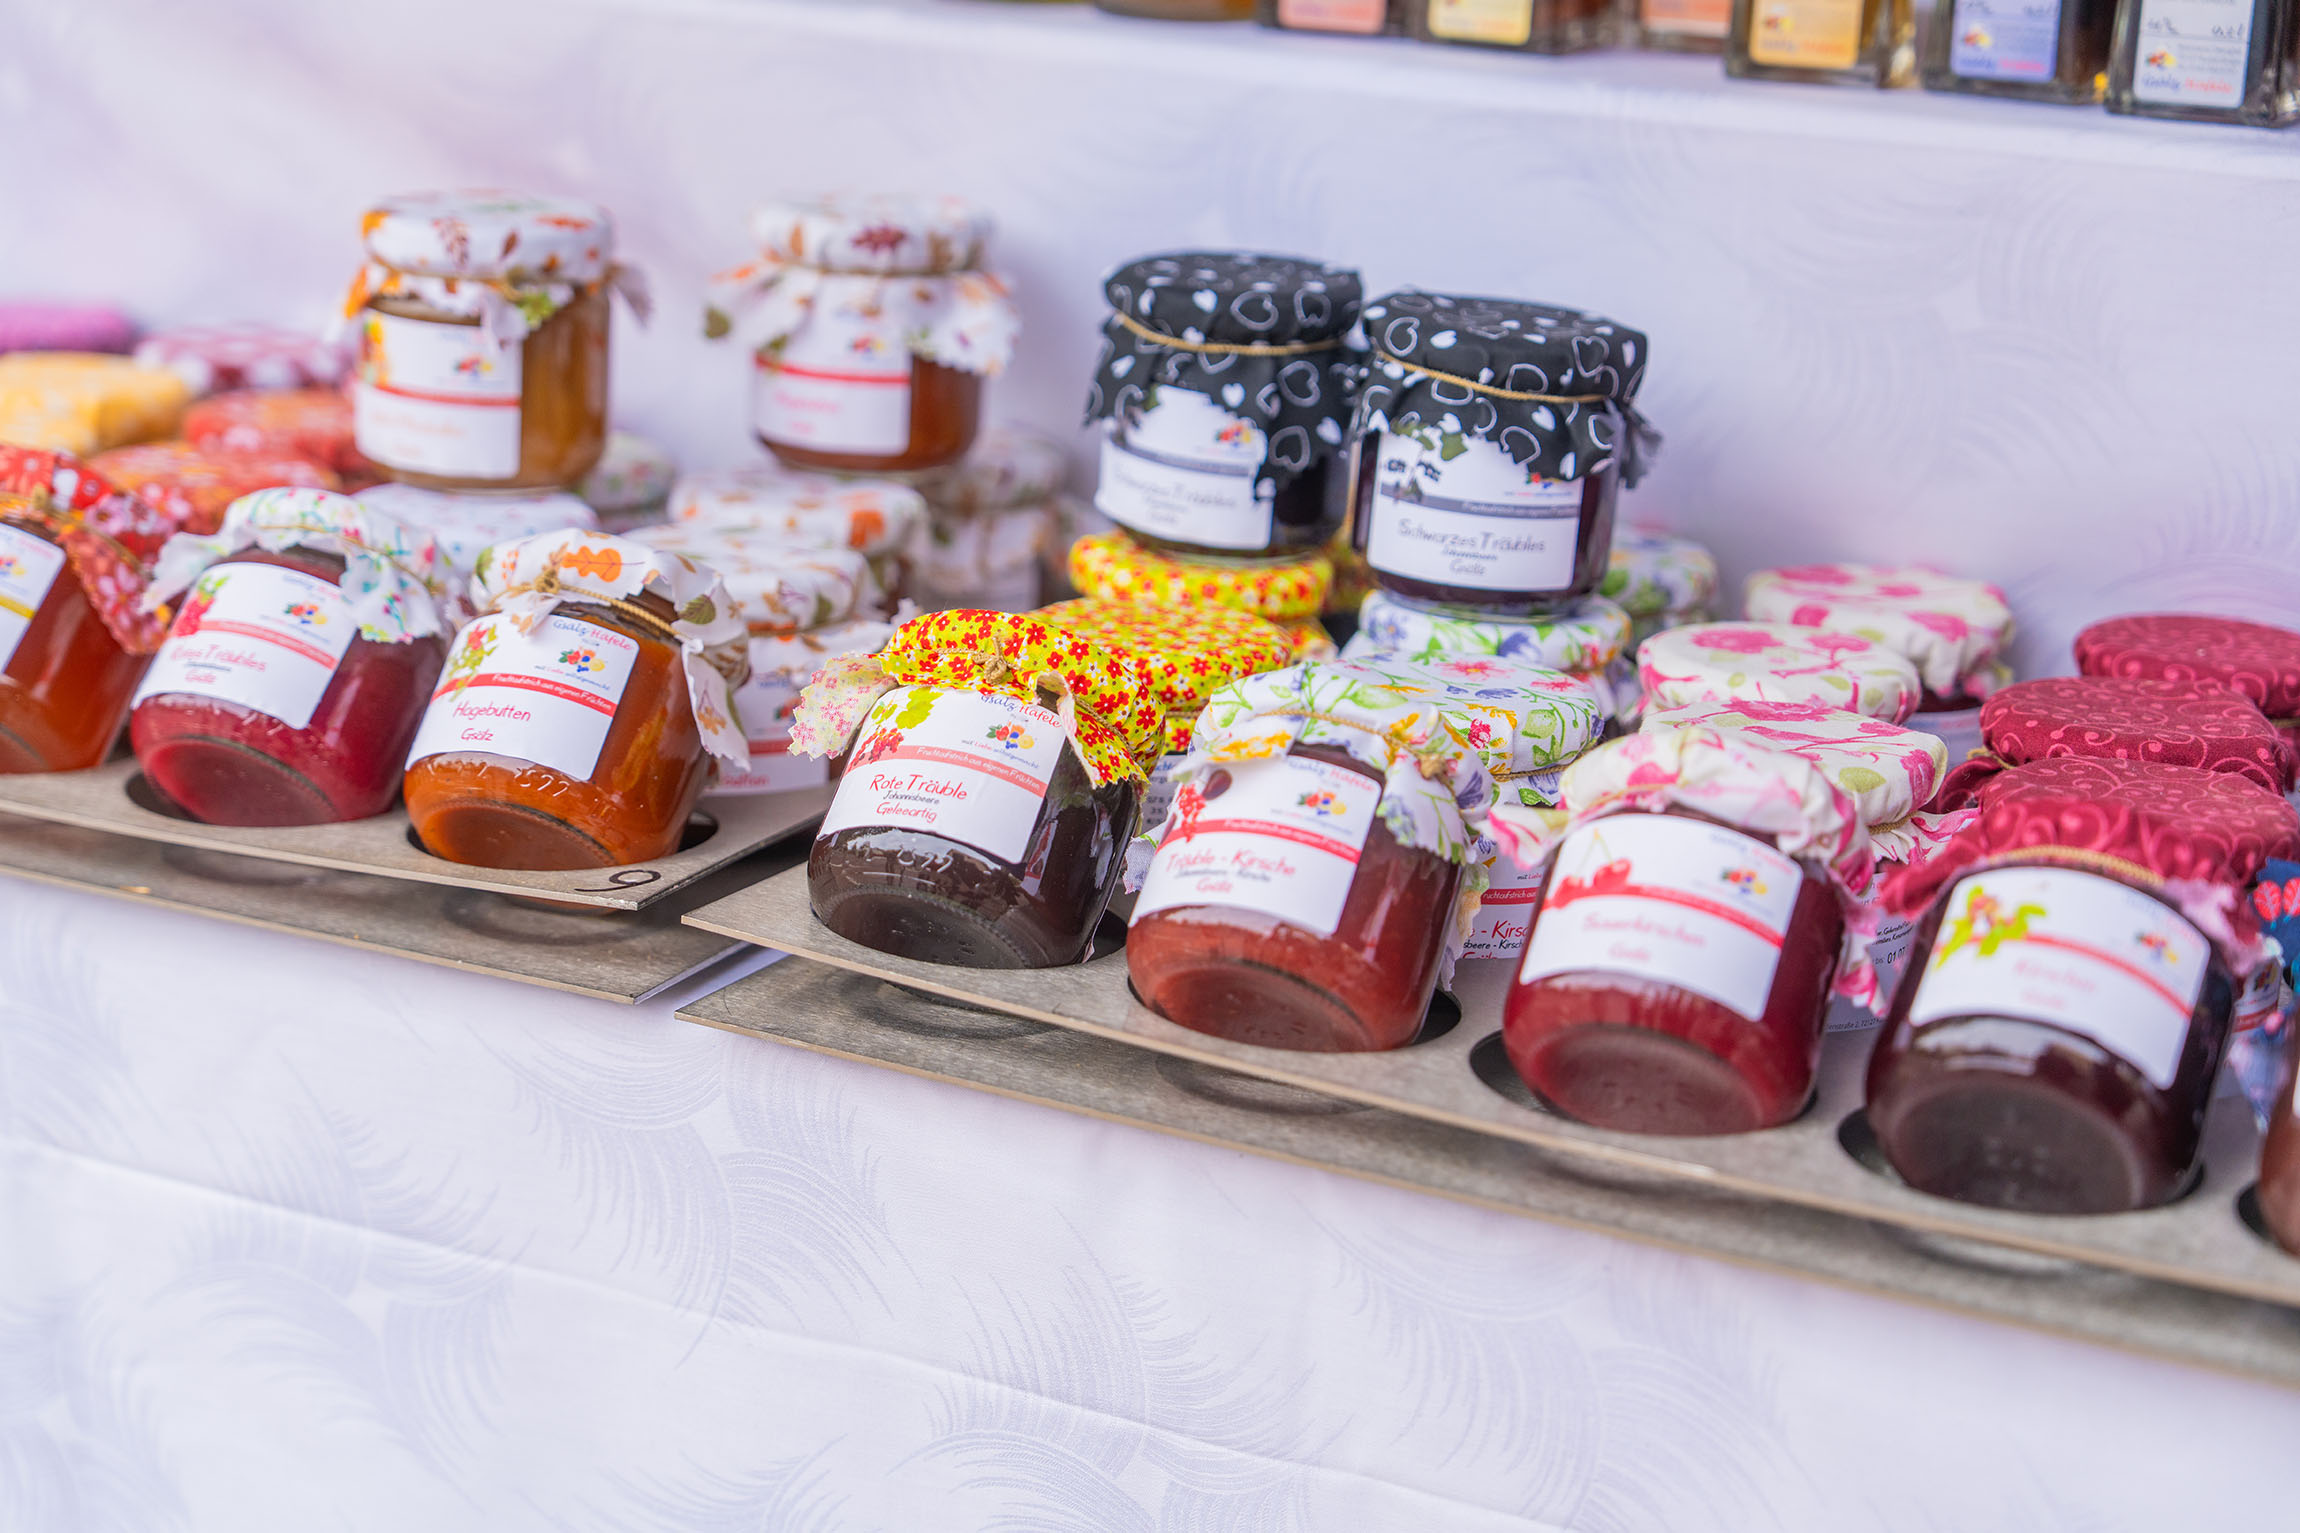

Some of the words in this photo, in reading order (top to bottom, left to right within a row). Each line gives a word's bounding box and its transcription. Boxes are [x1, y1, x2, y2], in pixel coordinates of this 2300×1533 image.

[453, 700, 531, 722] Hagebutten
[869, 773, 903, 791] Rote
[907, 774, 968, 800] Träuble
[876, 801, 938, 824] Geleeartig
